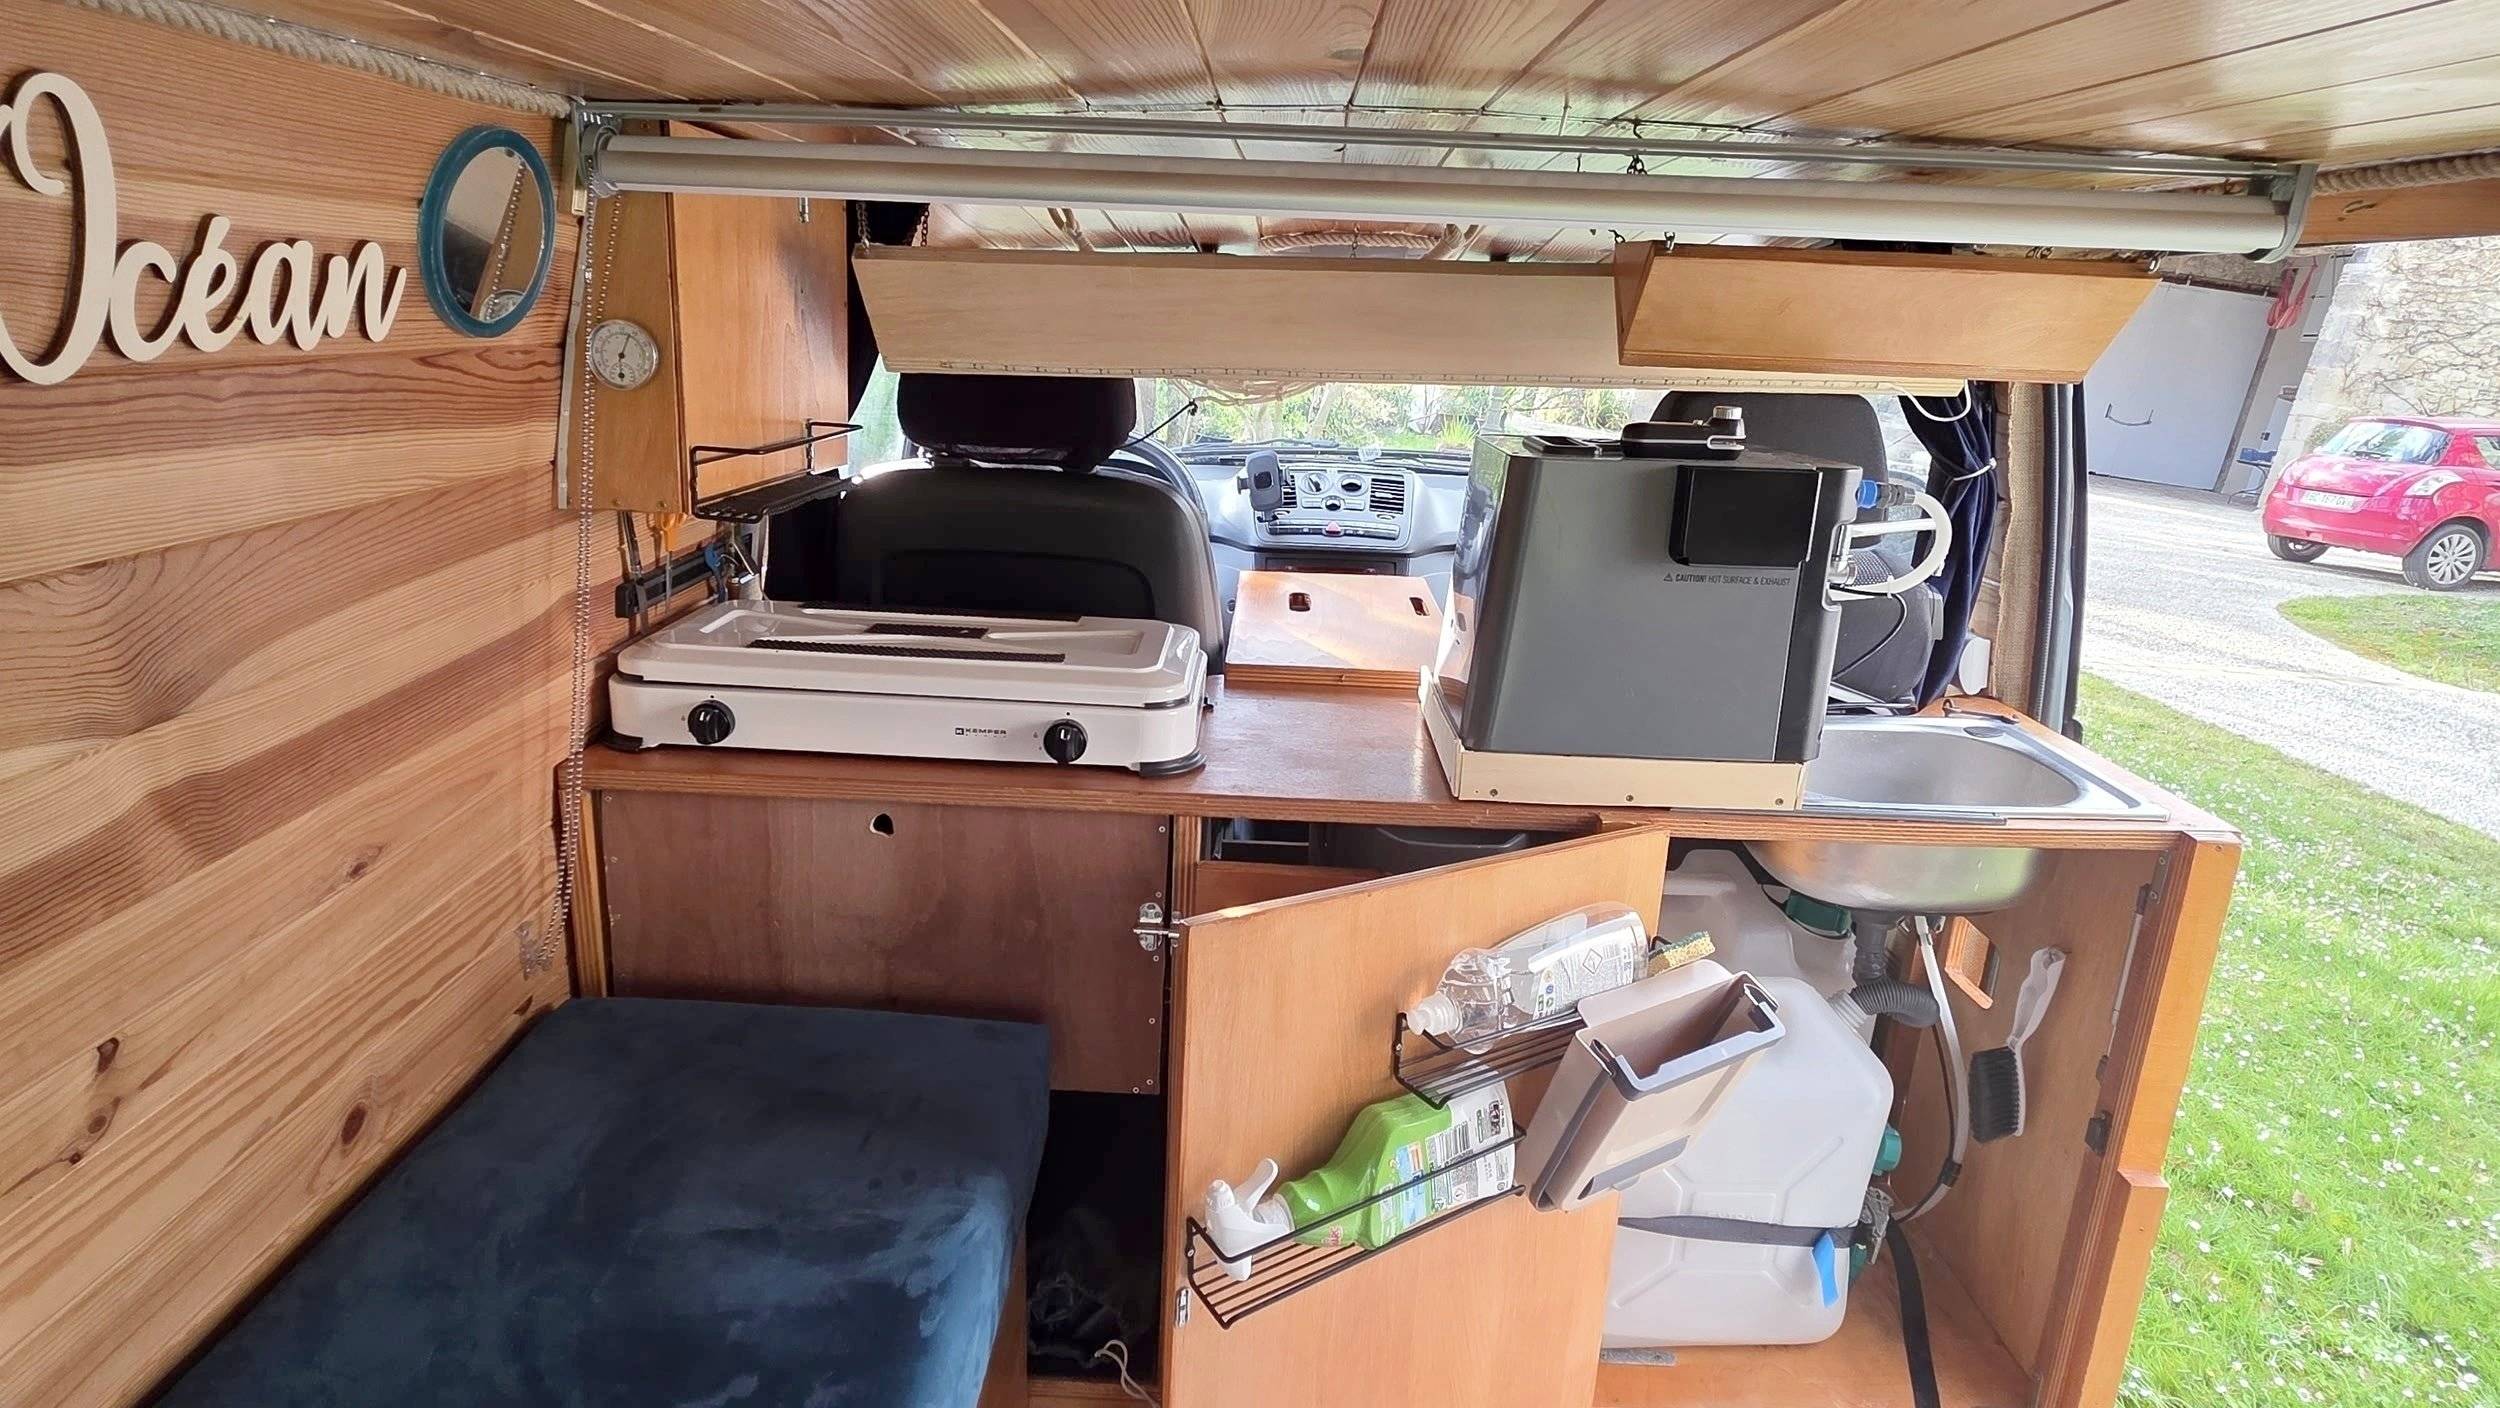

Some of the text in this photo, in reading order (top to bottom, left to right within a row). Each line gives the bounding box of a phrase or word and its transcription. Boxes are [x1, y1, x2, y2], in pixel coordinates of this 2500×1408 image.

[1675, 573, 1706, 583] CAUTION!
[1708, 574, 1721, 584] HOT
[1722, 575, 1752, 585] SURFACE
[1760, 576, 1790, 586] EXHAUST
